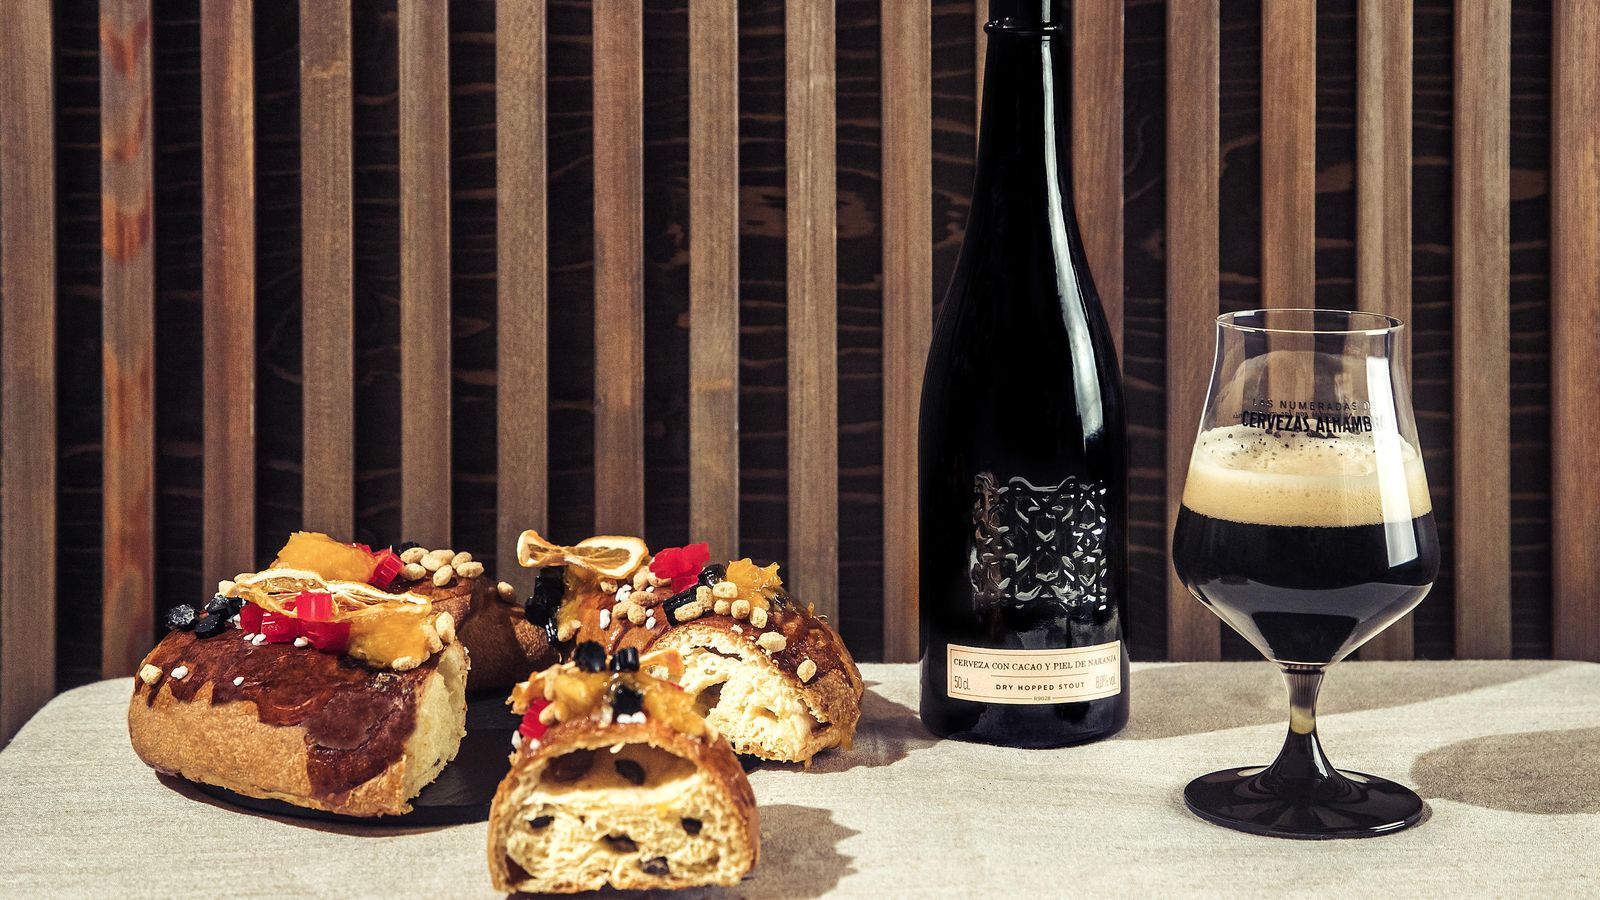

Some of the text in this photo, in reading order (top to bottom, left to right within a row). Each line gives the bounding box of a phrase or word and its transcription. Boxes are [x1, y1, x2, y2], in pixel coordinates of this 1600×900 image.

[1252, 399, 1274, 408] LAS
[1280, 400, 1357, 411] NUMERADAS
[1242, 410, 1310, 433] CERVEZAS
[953, 655, 1117, 671] CERVEZA CON CACAO Y PIEL DE NARANJA
[954, 675, 963, 690] 50
[995, 683, 1013, 691] DRY
[1058, 681, 1085, 690] STOUT
